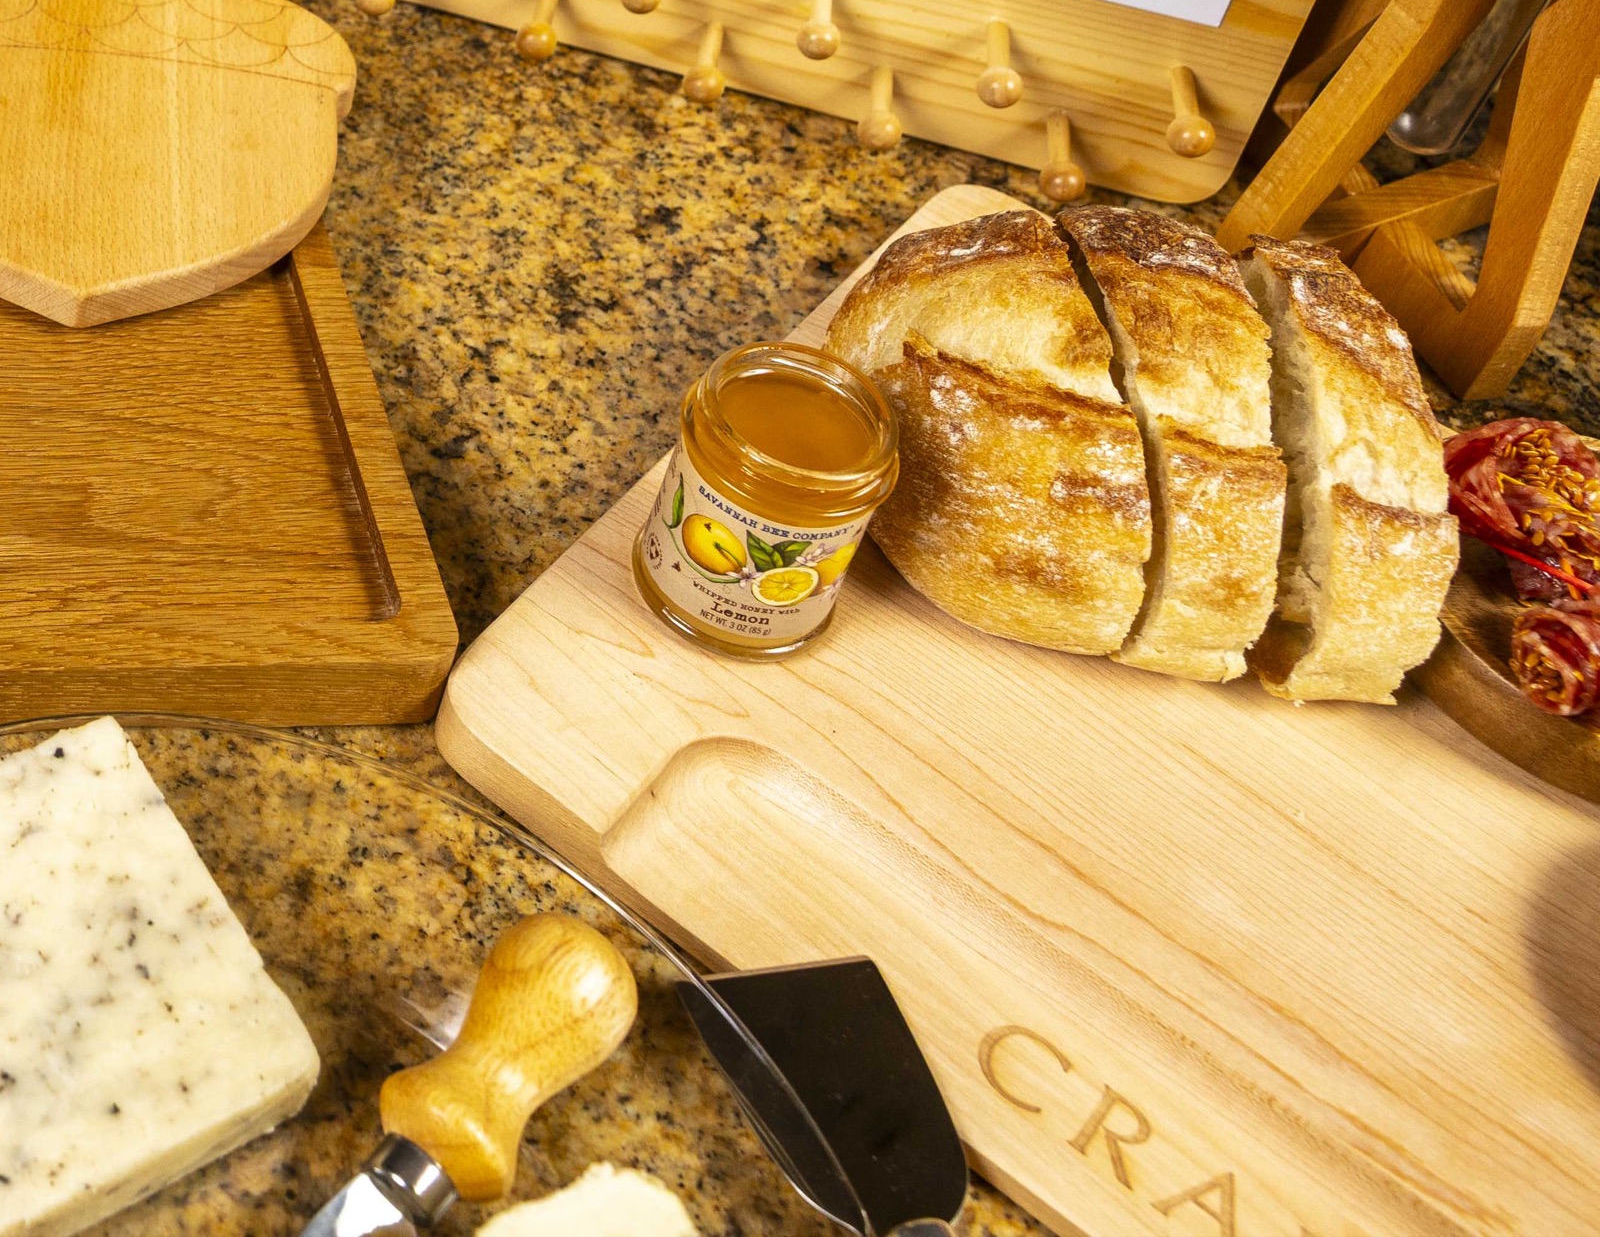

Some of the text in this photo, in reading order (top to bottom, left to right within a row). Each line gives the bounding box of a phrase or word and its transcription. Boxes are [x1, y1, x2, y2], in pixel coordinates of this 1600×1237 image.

[699, 485, 850, 541] SAVANNAH BEE COMPANY
[693, 580, 801, 615] WHIPPED HONEY with
[710, 601, 770, 625] Lemon
[700, 609, 714, 621] NET
[715, 615, 727, 626] WT.
[736, 623, 748, 632] OZ
[749, 627, 761, 635] (85
[762, 628, 772, 636] g)
